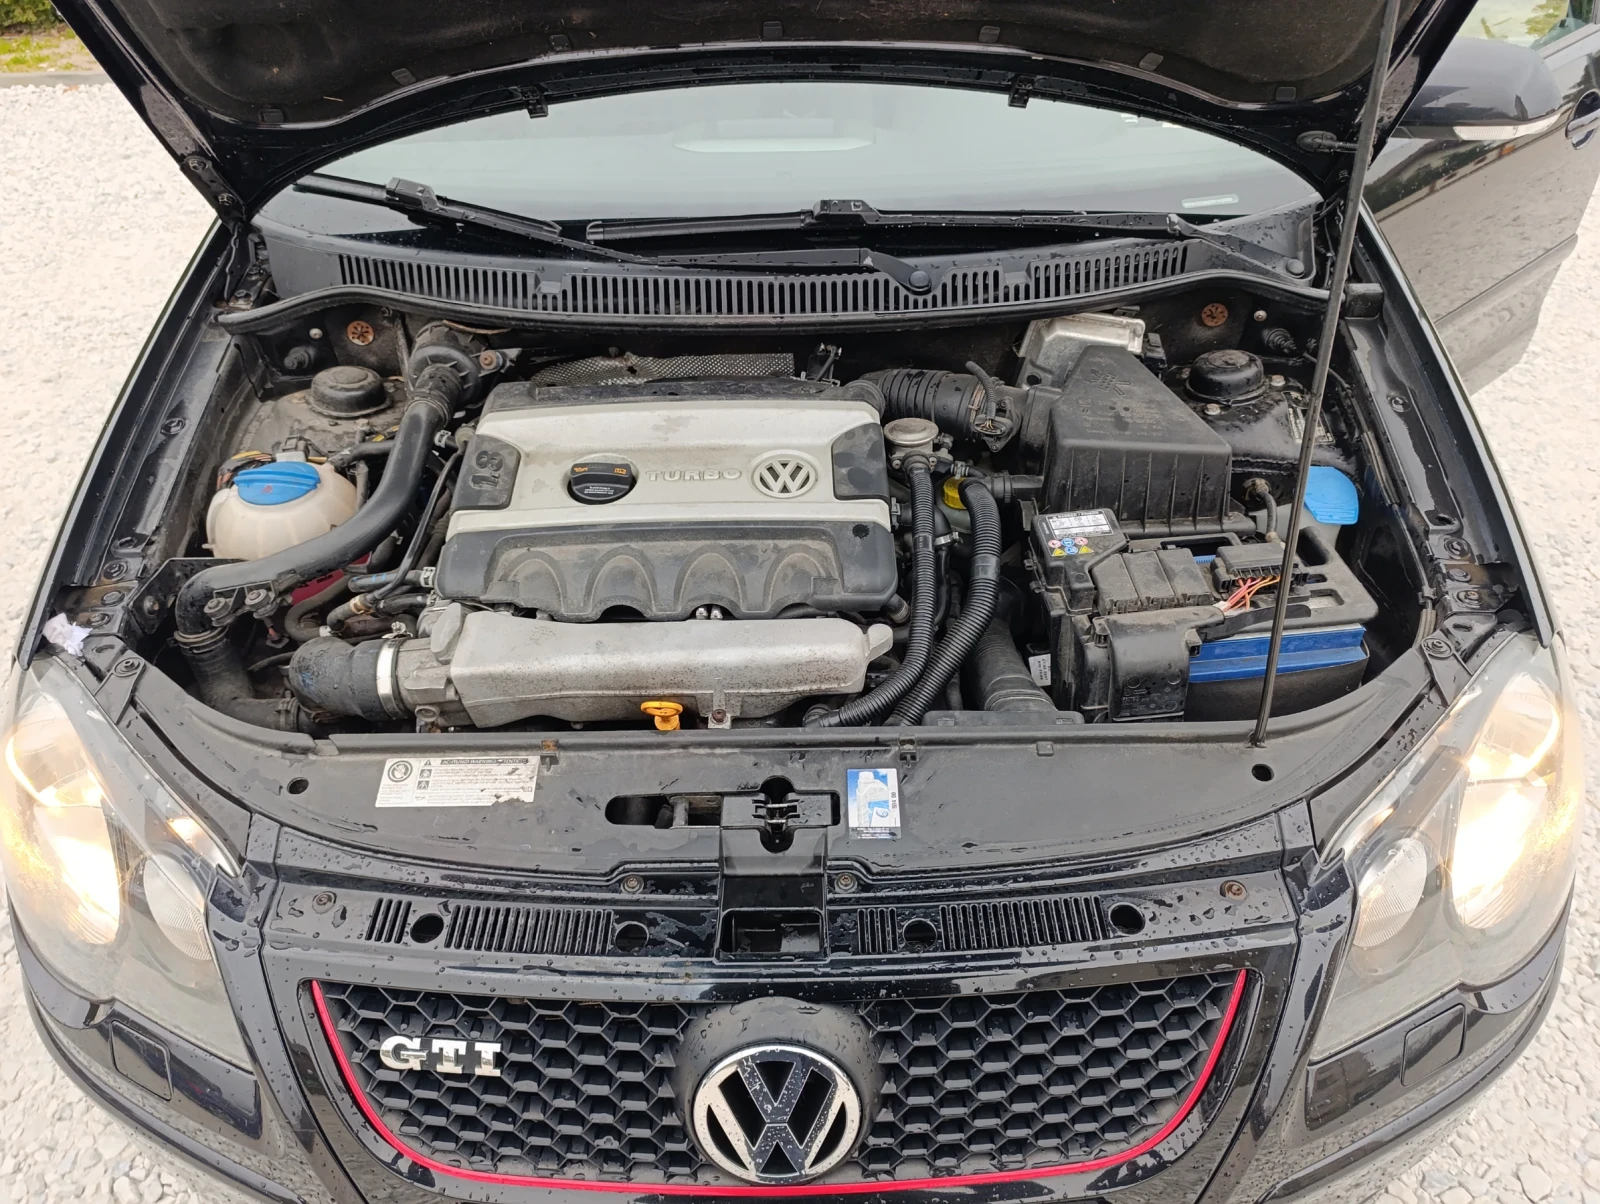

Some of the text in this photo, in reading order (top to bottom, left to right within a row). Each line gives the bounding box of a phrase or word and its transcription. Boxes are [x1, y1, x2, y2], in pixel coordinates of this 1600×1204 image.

[470, 450, 504, 490] 1.8
[646, 468, 743, 482] TURBO
[380, 1035, 502, 1077] GTI
[693, 1045, 861, 1184] VW
